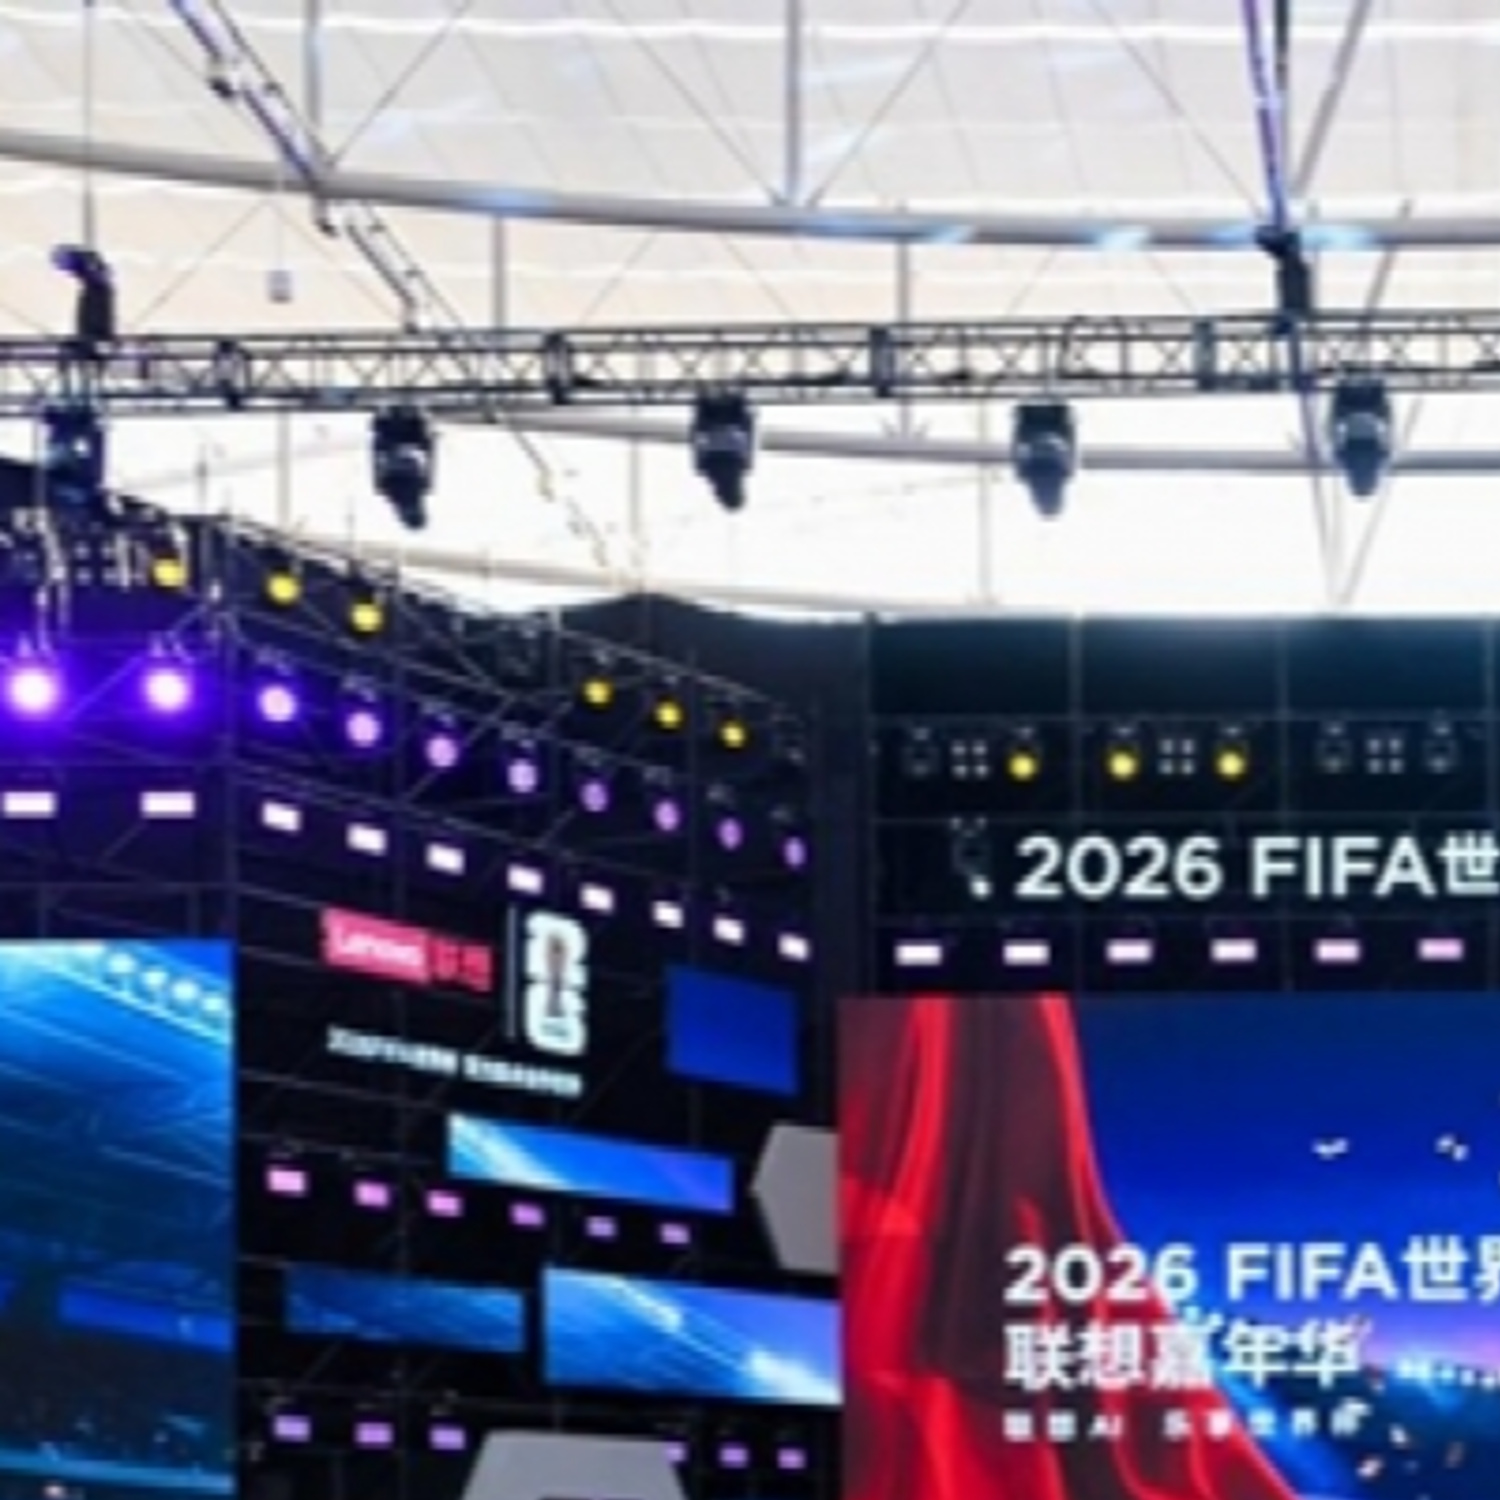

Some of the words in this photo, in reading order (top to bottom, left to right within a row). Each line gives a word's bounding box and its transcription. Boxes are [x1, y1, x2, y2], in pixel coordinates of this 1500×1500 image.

[1015, 834, 1224, 897] 2026
[1004, 1246, 1198, 1302] 2026
[1004, 1318, 1362, 1390] 联想嘉年华
